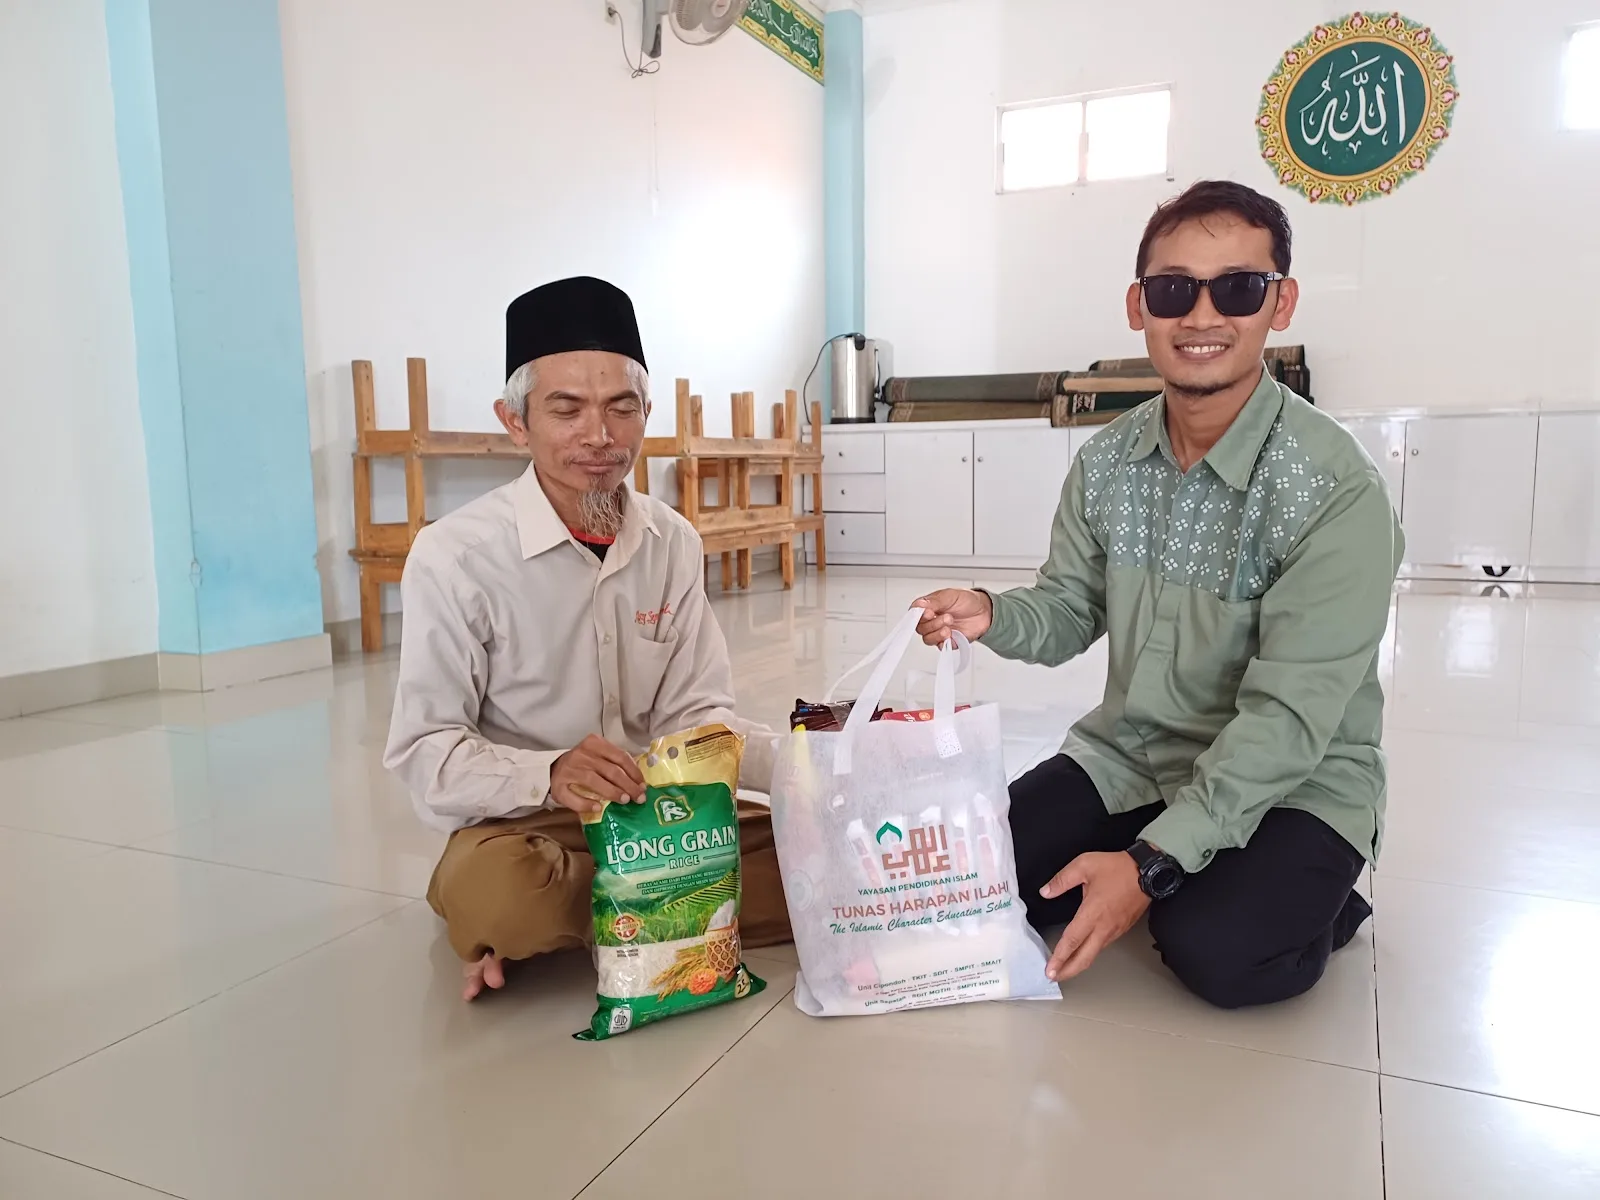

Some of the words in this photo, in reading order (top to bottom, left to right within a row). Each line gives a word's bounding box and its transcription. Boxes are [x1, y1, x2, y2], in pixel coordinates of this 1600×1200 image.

[605, 834, 675, 865] LONG
[681, 825, 736, 852] GRAIN
[668, 854, 700, 870] RICE
[832, 903, 886, 920] TUNAS
[890, 890, 970, 915] HARAPAN
[974, 880, 1010, 901] ILAHI
[858, 885, 897, 896] YAYASAN
[898, 876, 951, 891] PENDIDIKAN
[952, 872, 978, 883] ISLAM
[829, 922, 846, 935] The
[849, 920, 884, 933] Islamic
[887, 916, 933, 932] Character
[937, 907, 982, 923] Education
[985, 898, 1012, 914] School
[857, 984, 872, 992] Unit
[873, 979, 906, 990] Cipondoh
[932, 969, 948, 977] SDIT
[954, 964, 975, 973] SMPIT
[980, 959, 1002, 967] SMAIT
[864, 999, 878, 1007] Unit
[957, 982, 978, 991] SMPIT
